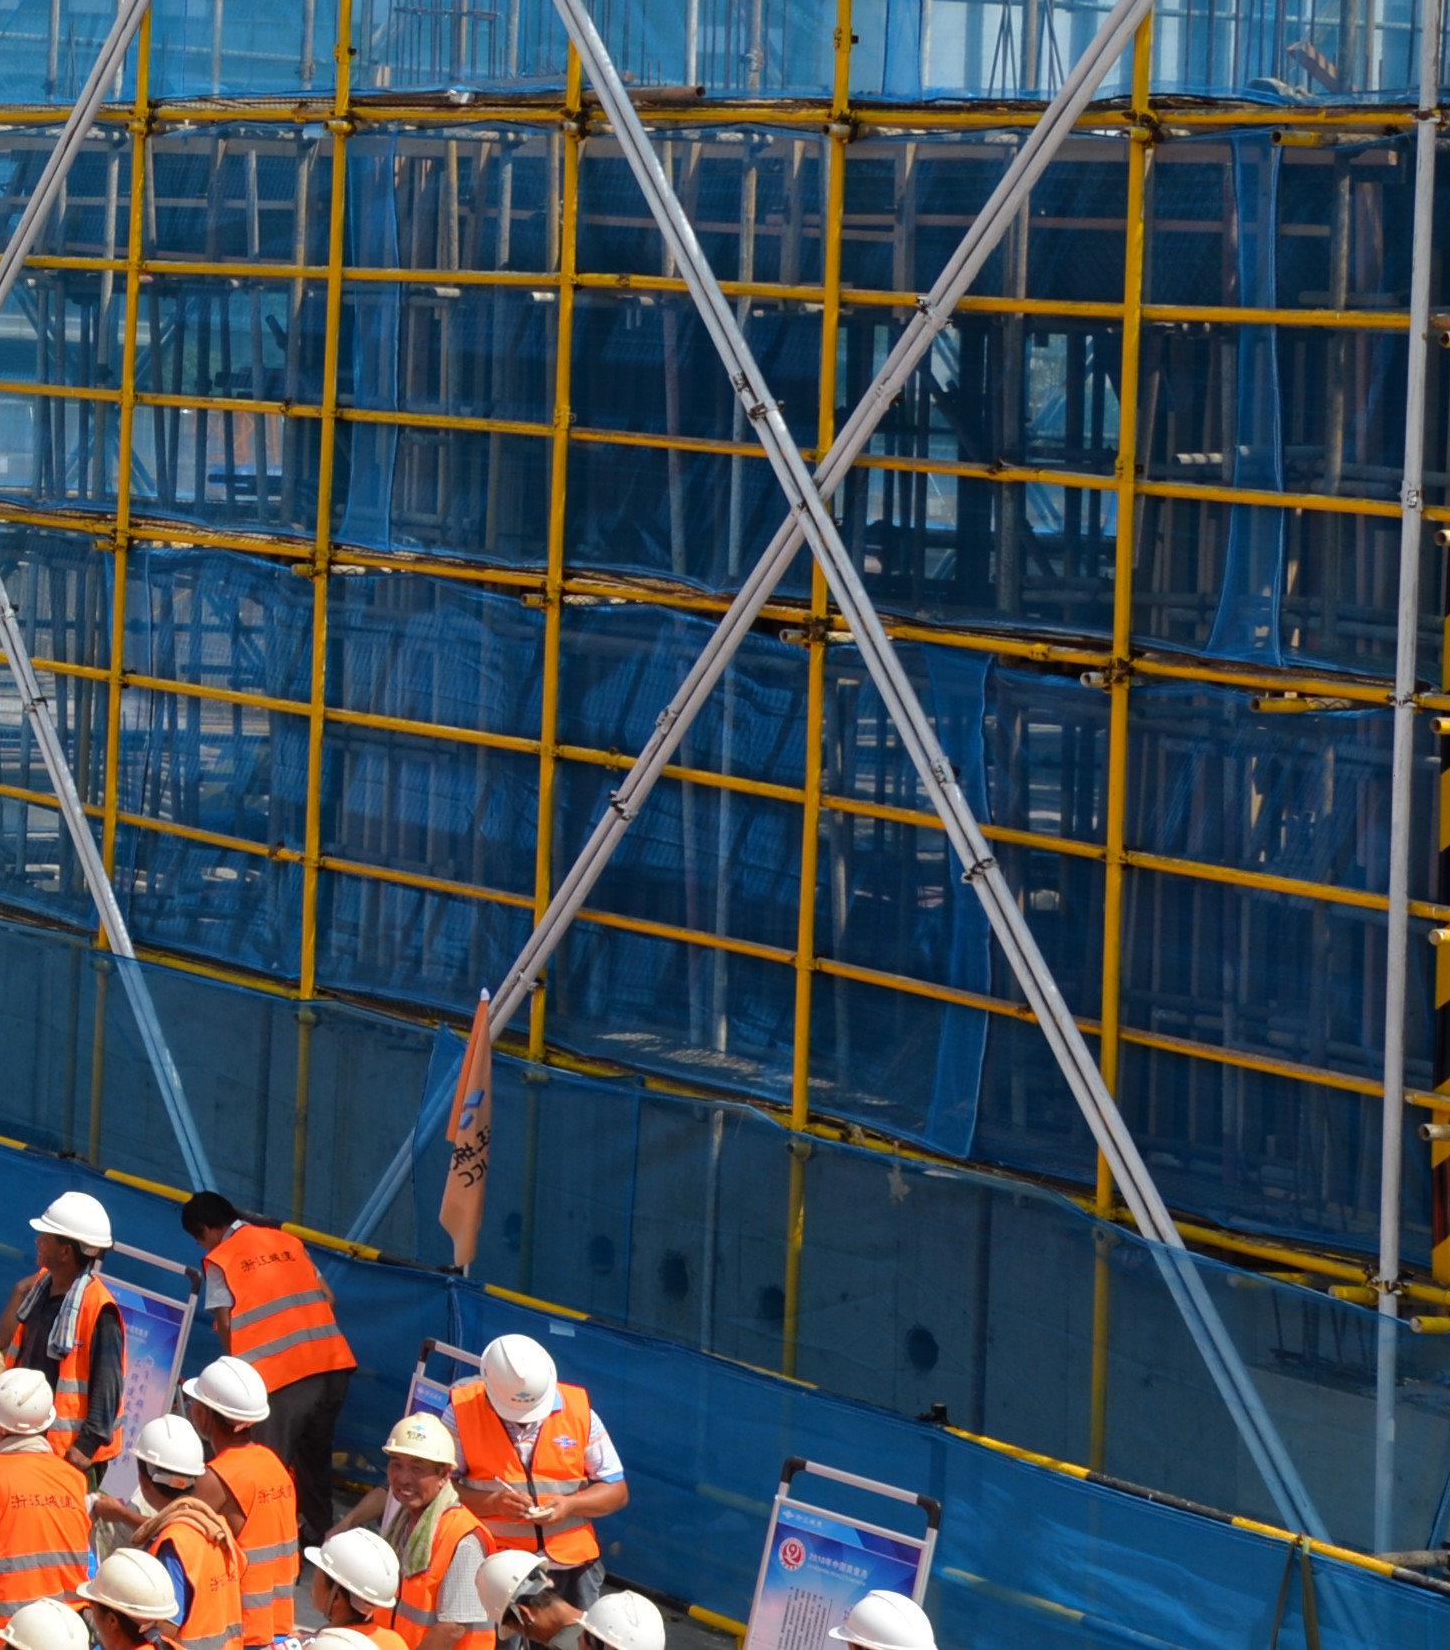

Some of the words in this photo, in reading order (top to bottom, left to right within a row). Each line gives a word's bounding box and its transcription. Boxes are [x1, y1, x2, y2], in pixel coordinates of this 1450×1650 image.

[240, 1251, 295, 1272] 浙江城建
[11, 1493, 75, 1511] 浙江城建
